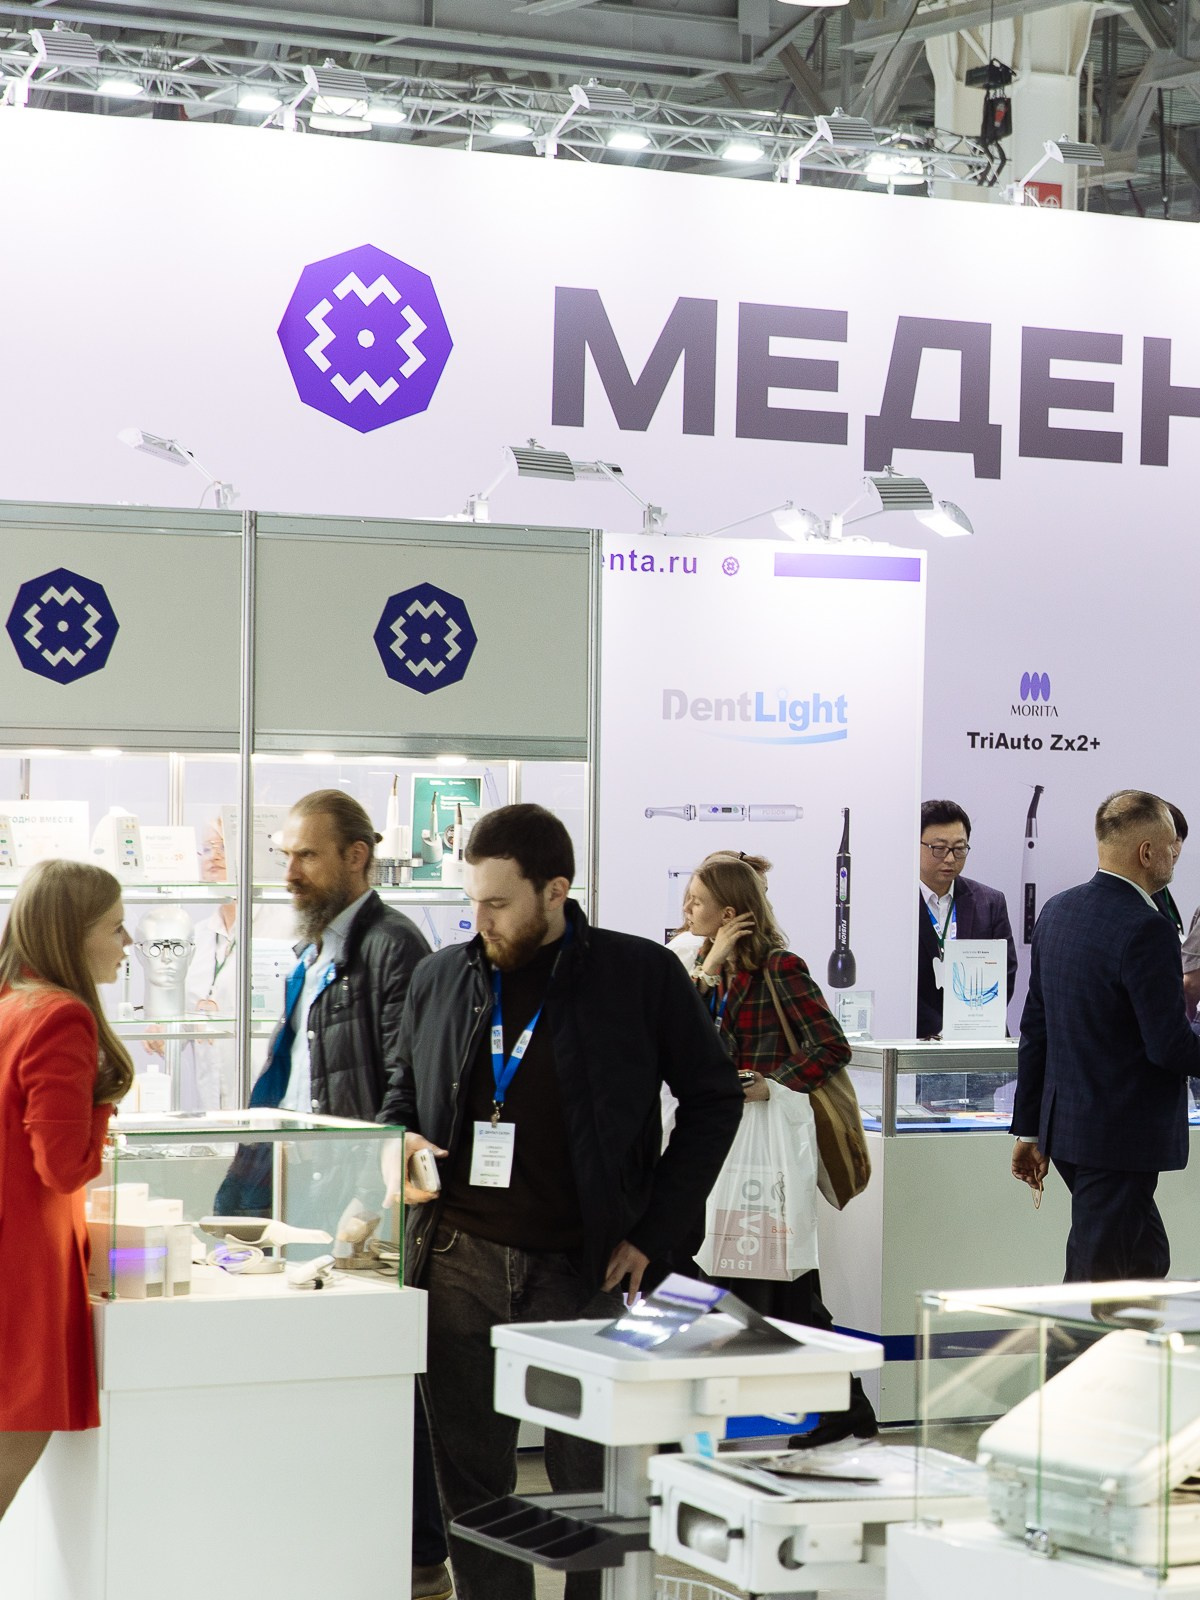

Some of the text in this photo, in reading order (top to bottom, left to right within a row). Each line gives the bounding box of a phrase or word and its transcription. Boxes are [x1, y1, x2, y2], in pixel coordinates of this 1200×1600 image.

[661, 687, 848, 731] DentLight
[1010, 704, 1059, 718] MORITA
[966, 731, 1101, 752] TriAuto Zx2+
